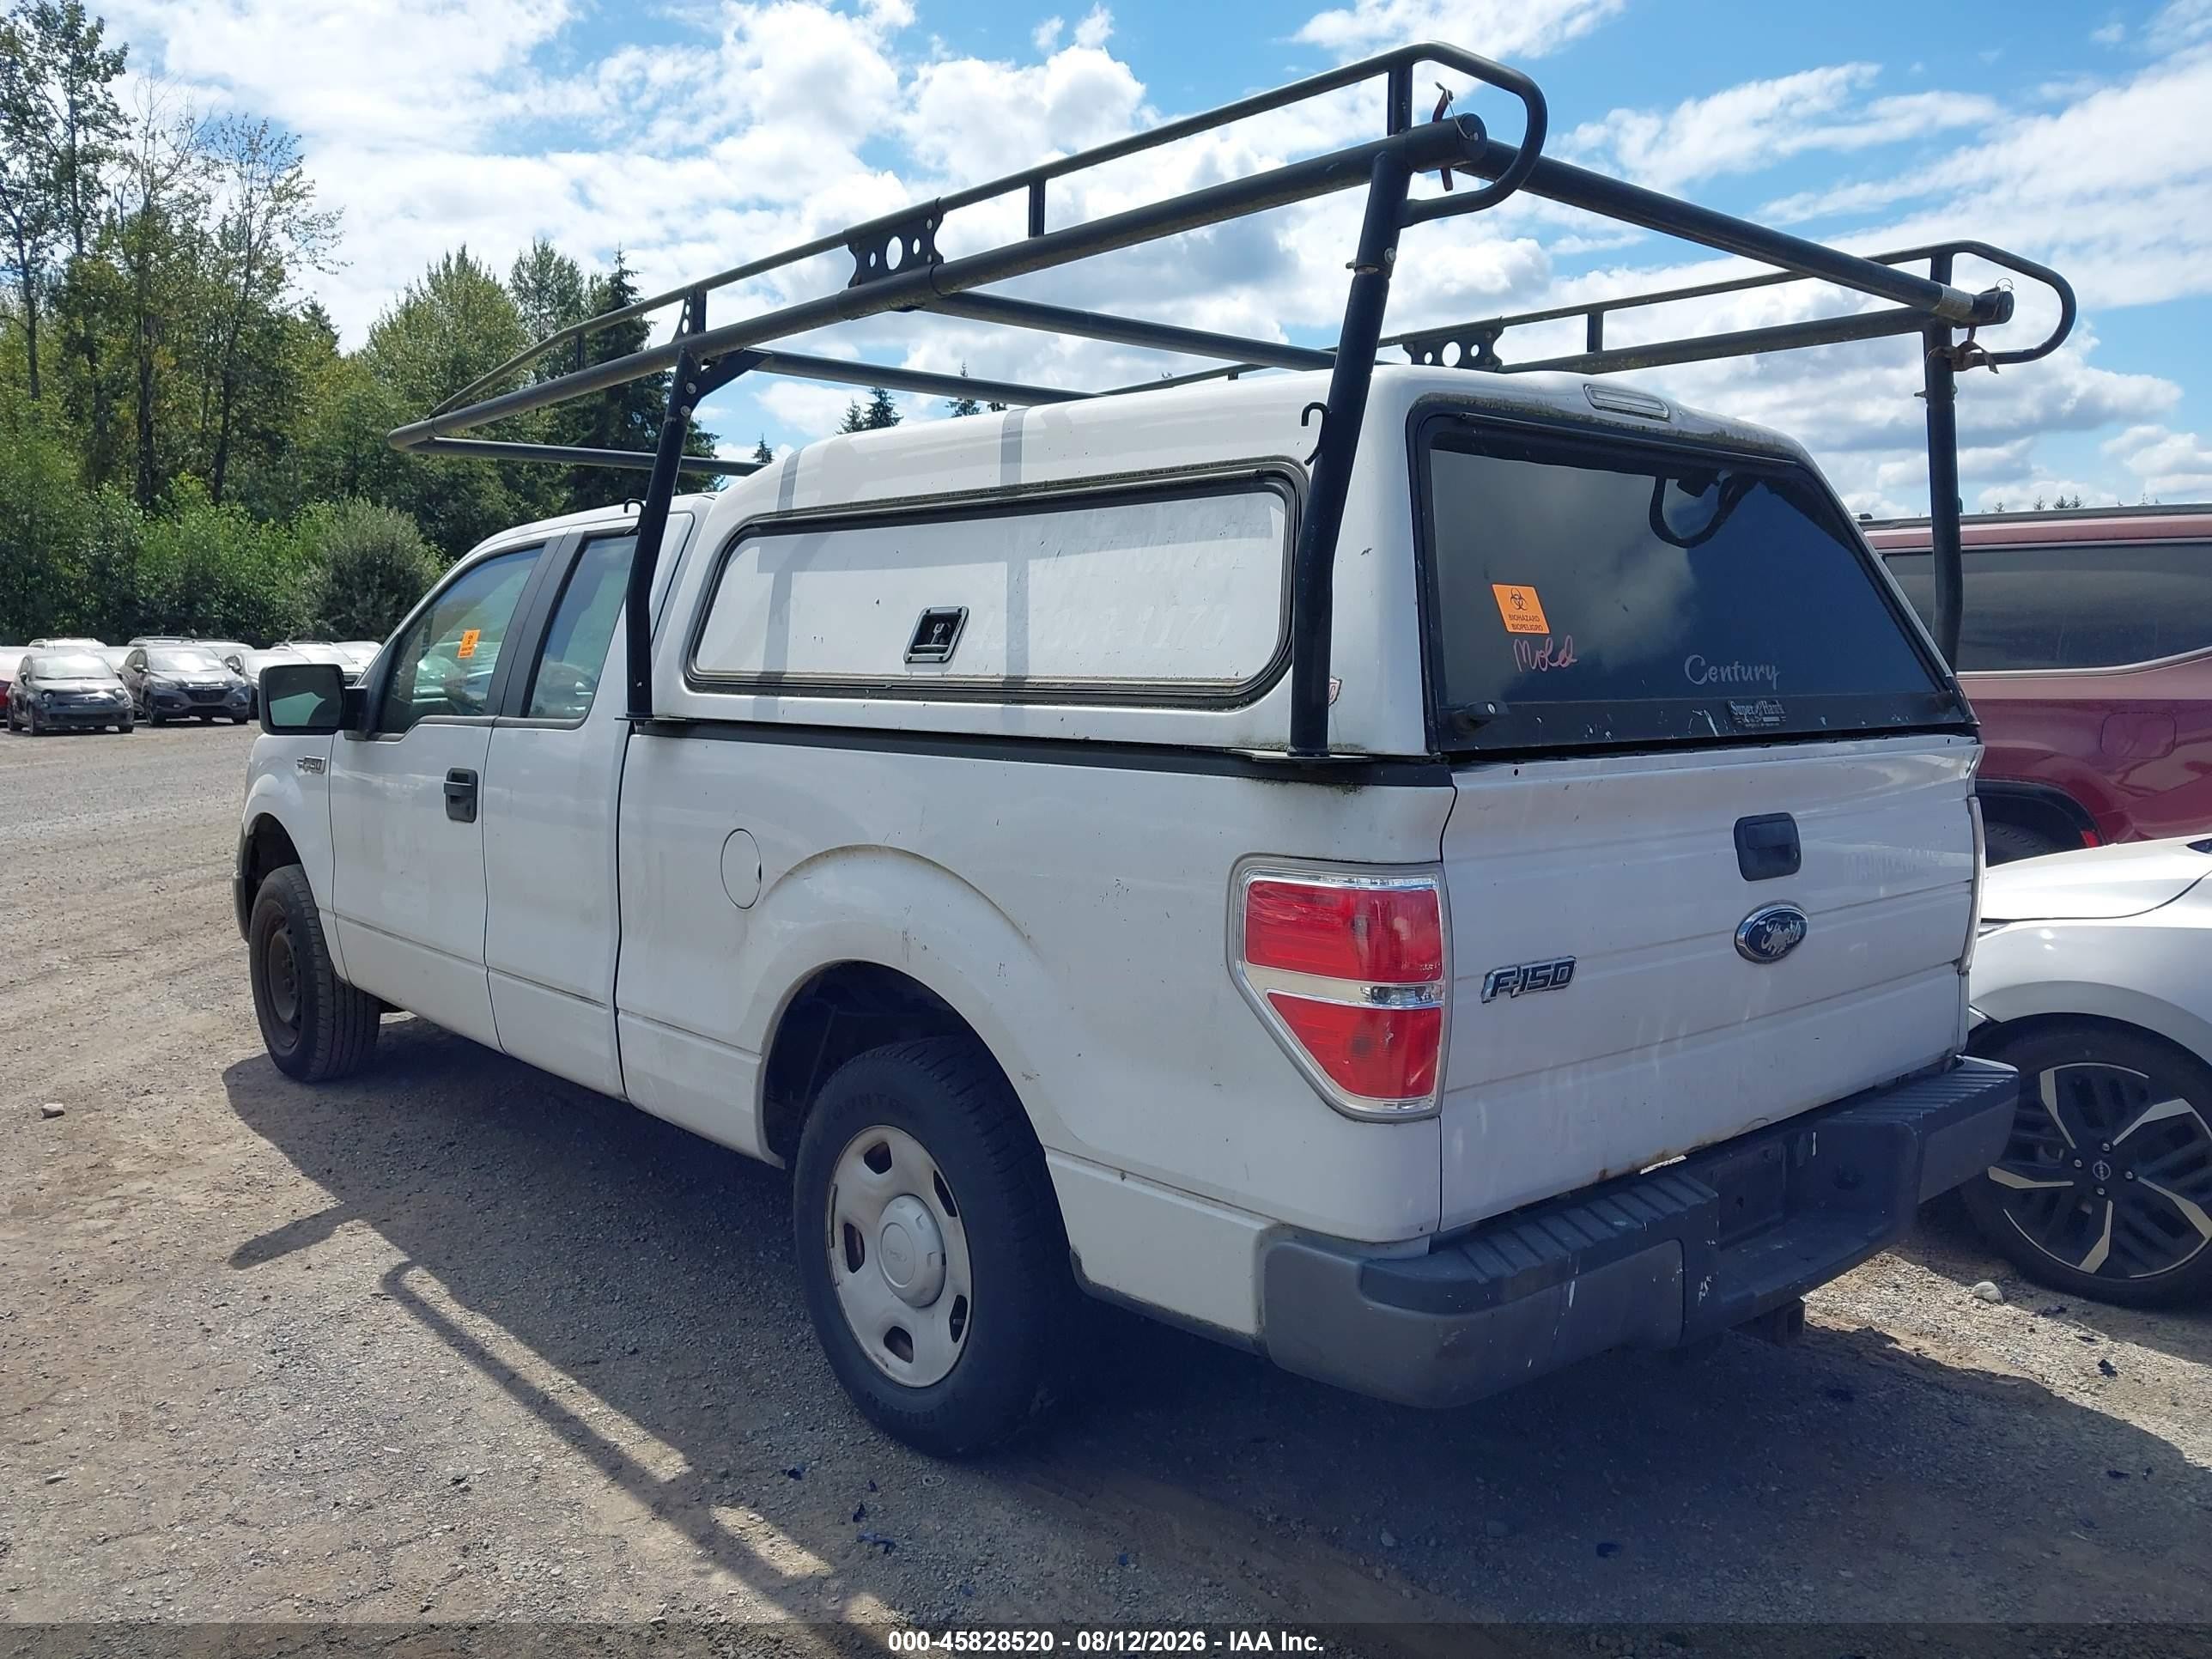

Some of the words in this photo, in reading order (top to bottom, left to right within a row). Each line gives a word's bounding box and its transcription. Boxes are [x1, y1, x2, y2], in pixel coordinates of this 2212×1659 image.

[1508, 613, 1540, 623] BIOHAZARD
[1510, 623, 1544, 632] BIOPELIGRO
[1513, 635, 1578, 672] Mold
[1684, 654, 1780, 690] Century
